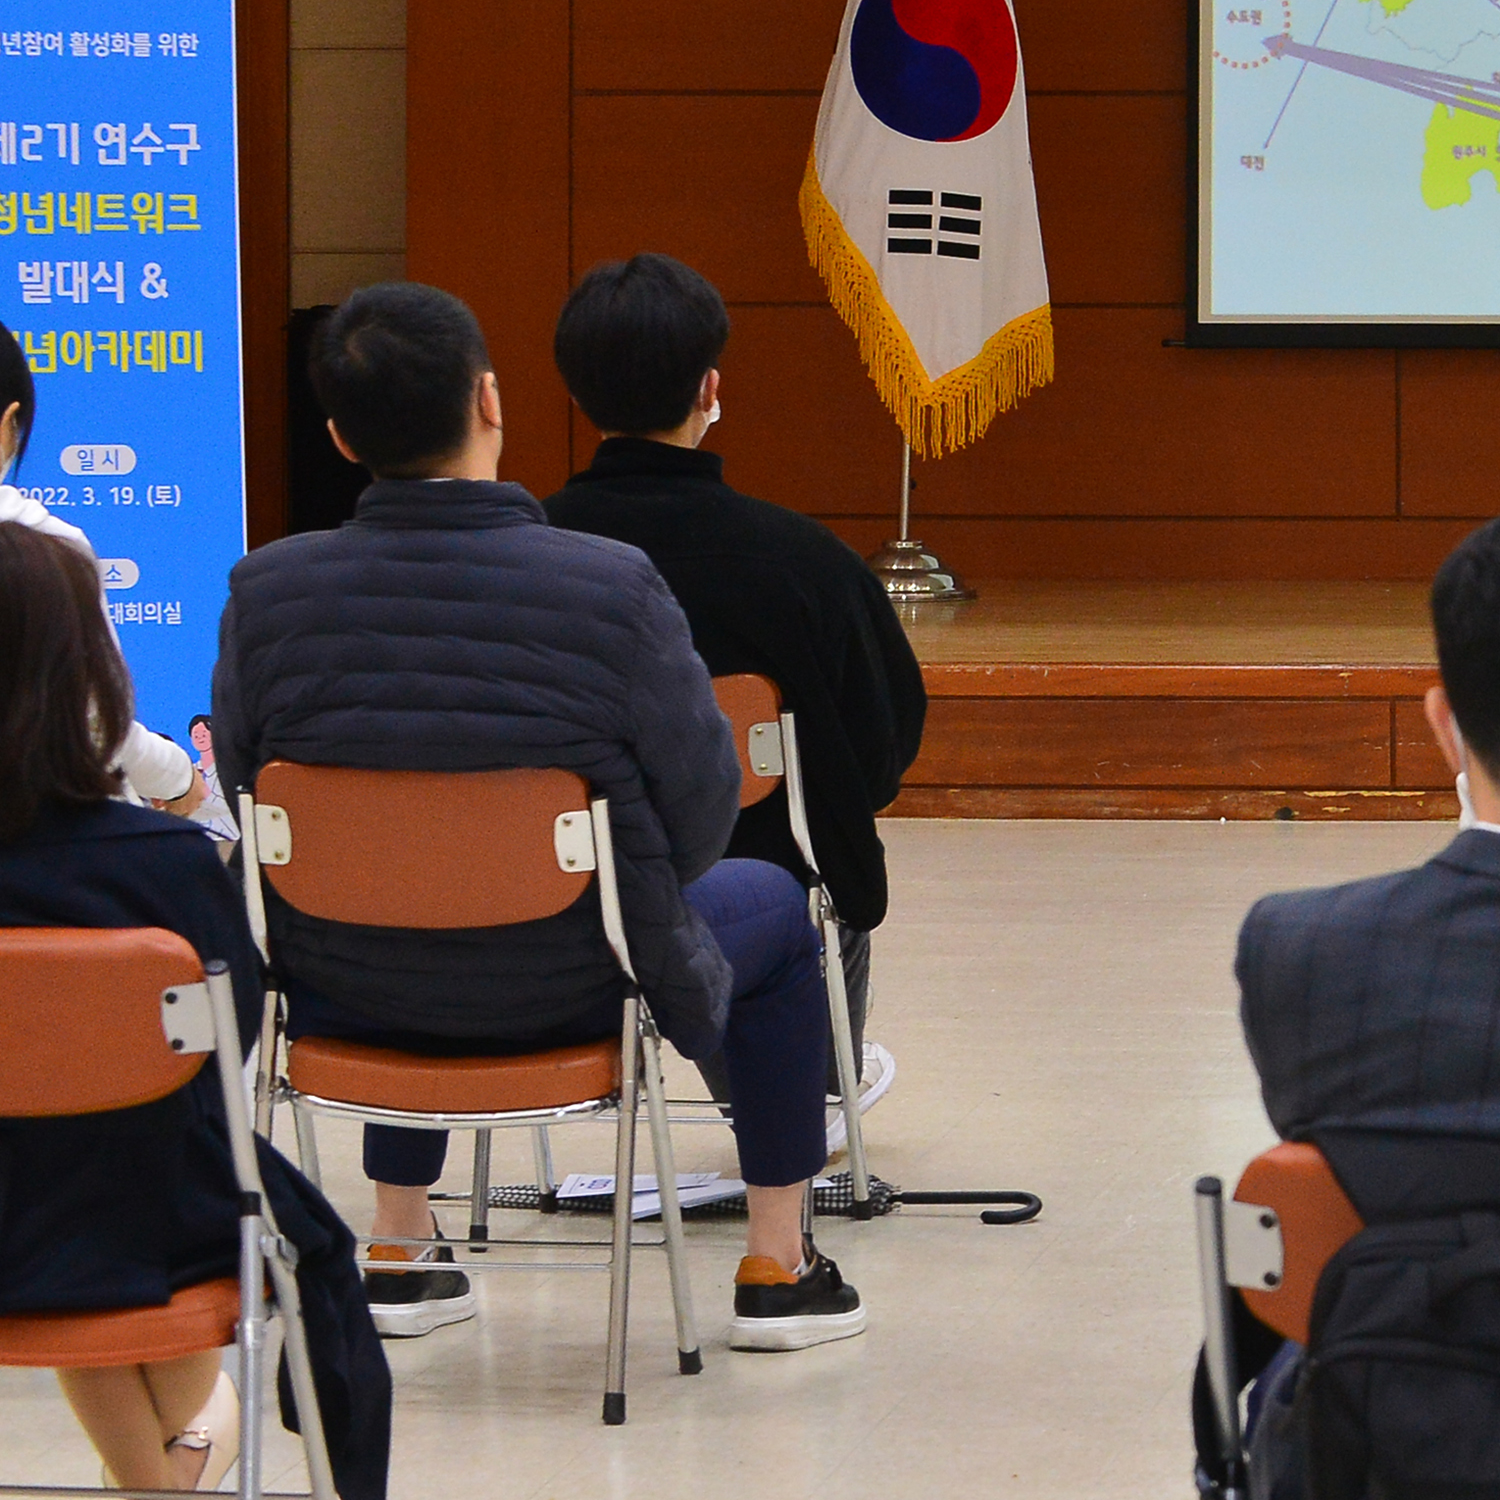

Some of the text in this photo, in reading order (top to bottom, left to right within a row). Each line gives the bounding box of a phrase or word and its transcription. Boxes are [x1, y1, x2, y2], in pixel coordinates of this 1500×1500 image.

[69, 31, 152, 58] 활성화를
[157, 32, 200, 58] 위한
[94, 122, 202, 166] 연수구
[17, 261, 169, 304] 발대식 &
[13, 329, 204, 373] 년아카데미
[82, 486, 102, 506] 3.
[109, 486, 141, 506] 19.
[146, 484, 182, 508] (토)
[103, 563, 123, 583] 소
